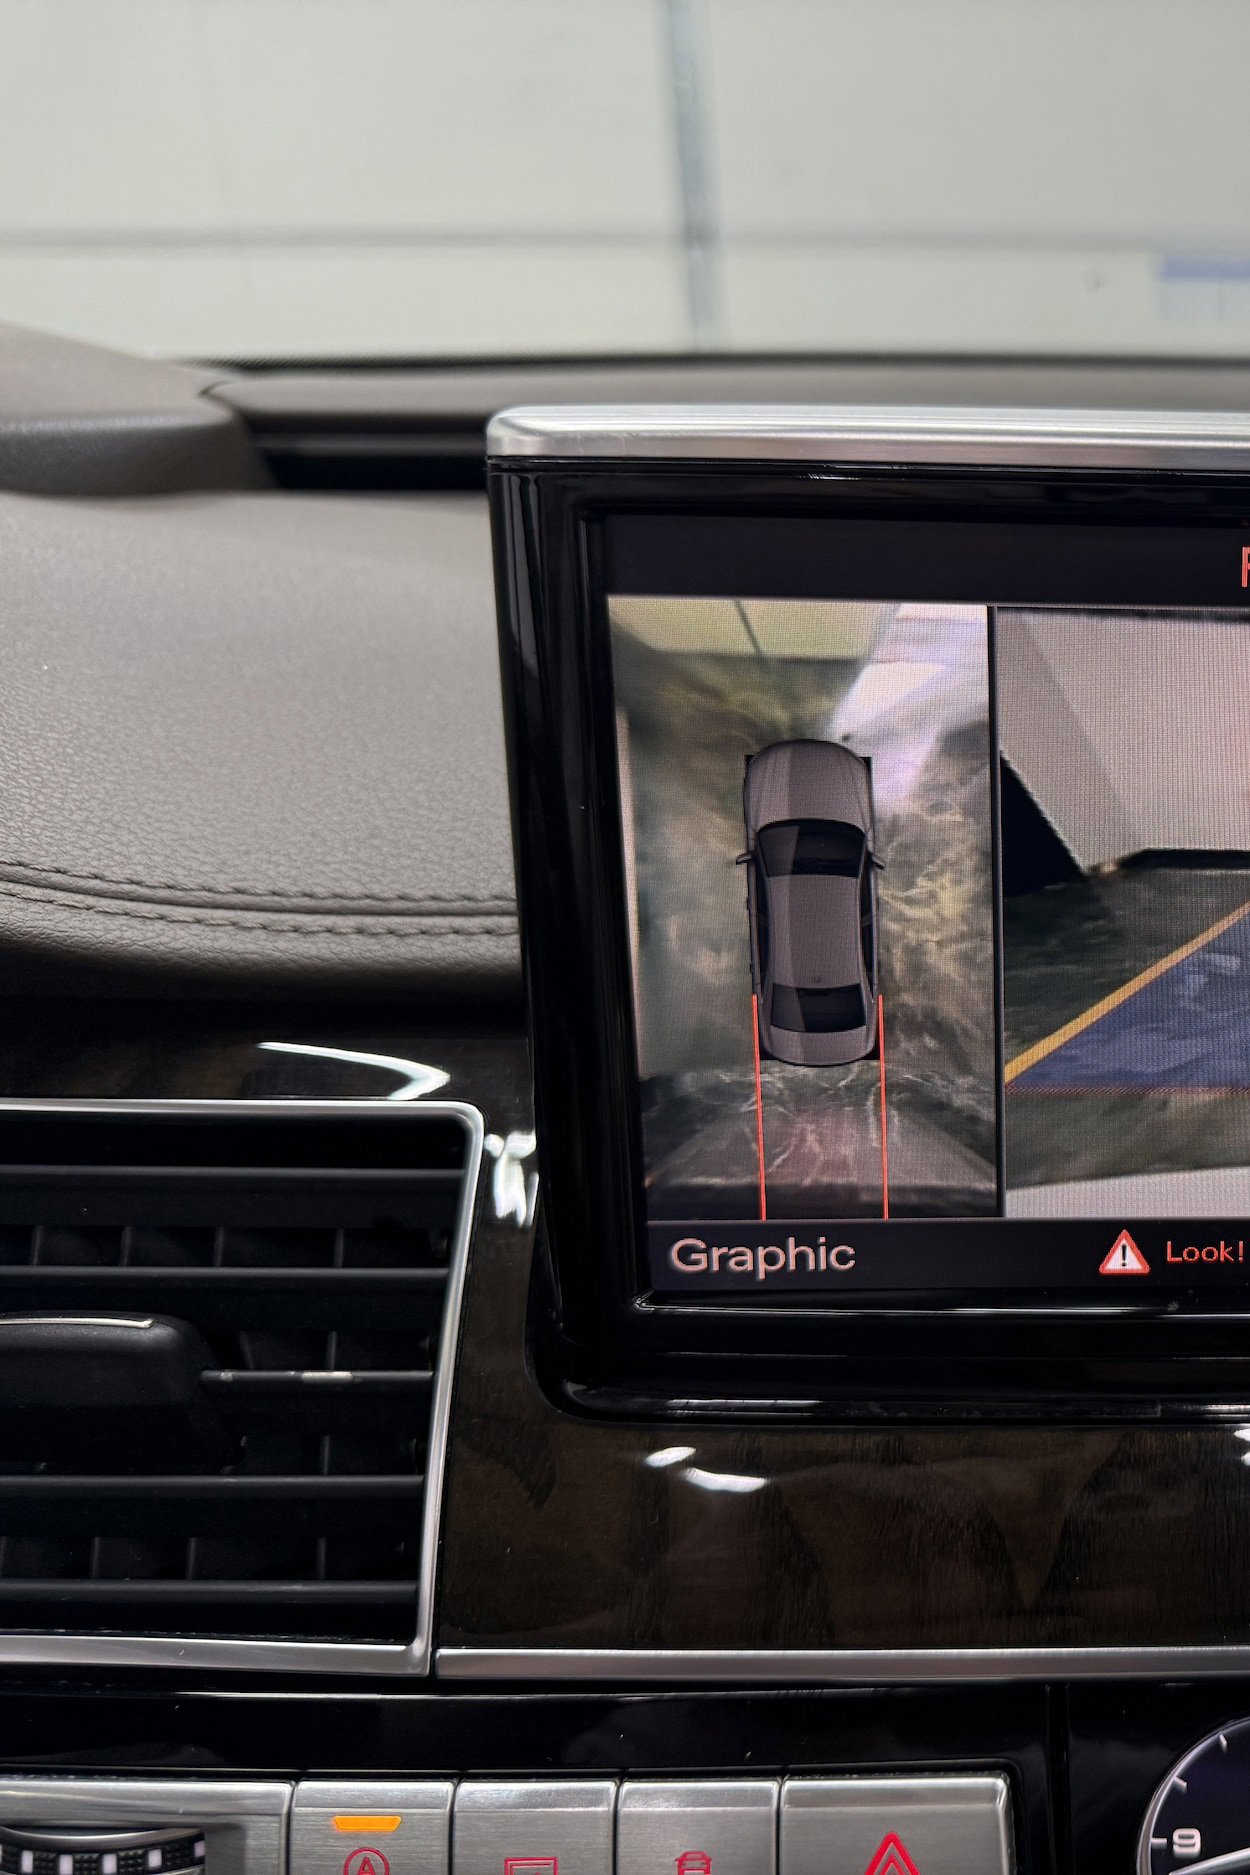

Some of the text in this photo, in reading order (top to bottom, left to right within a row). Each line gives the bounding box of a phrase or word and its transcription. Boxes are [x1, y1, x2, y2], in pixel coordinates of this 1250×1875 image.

[670, 1236, 856, 1281] Graphic
[1166, 1240, 1244, 1263] Look!
[1172, 1828, 1201, 1855] 9
